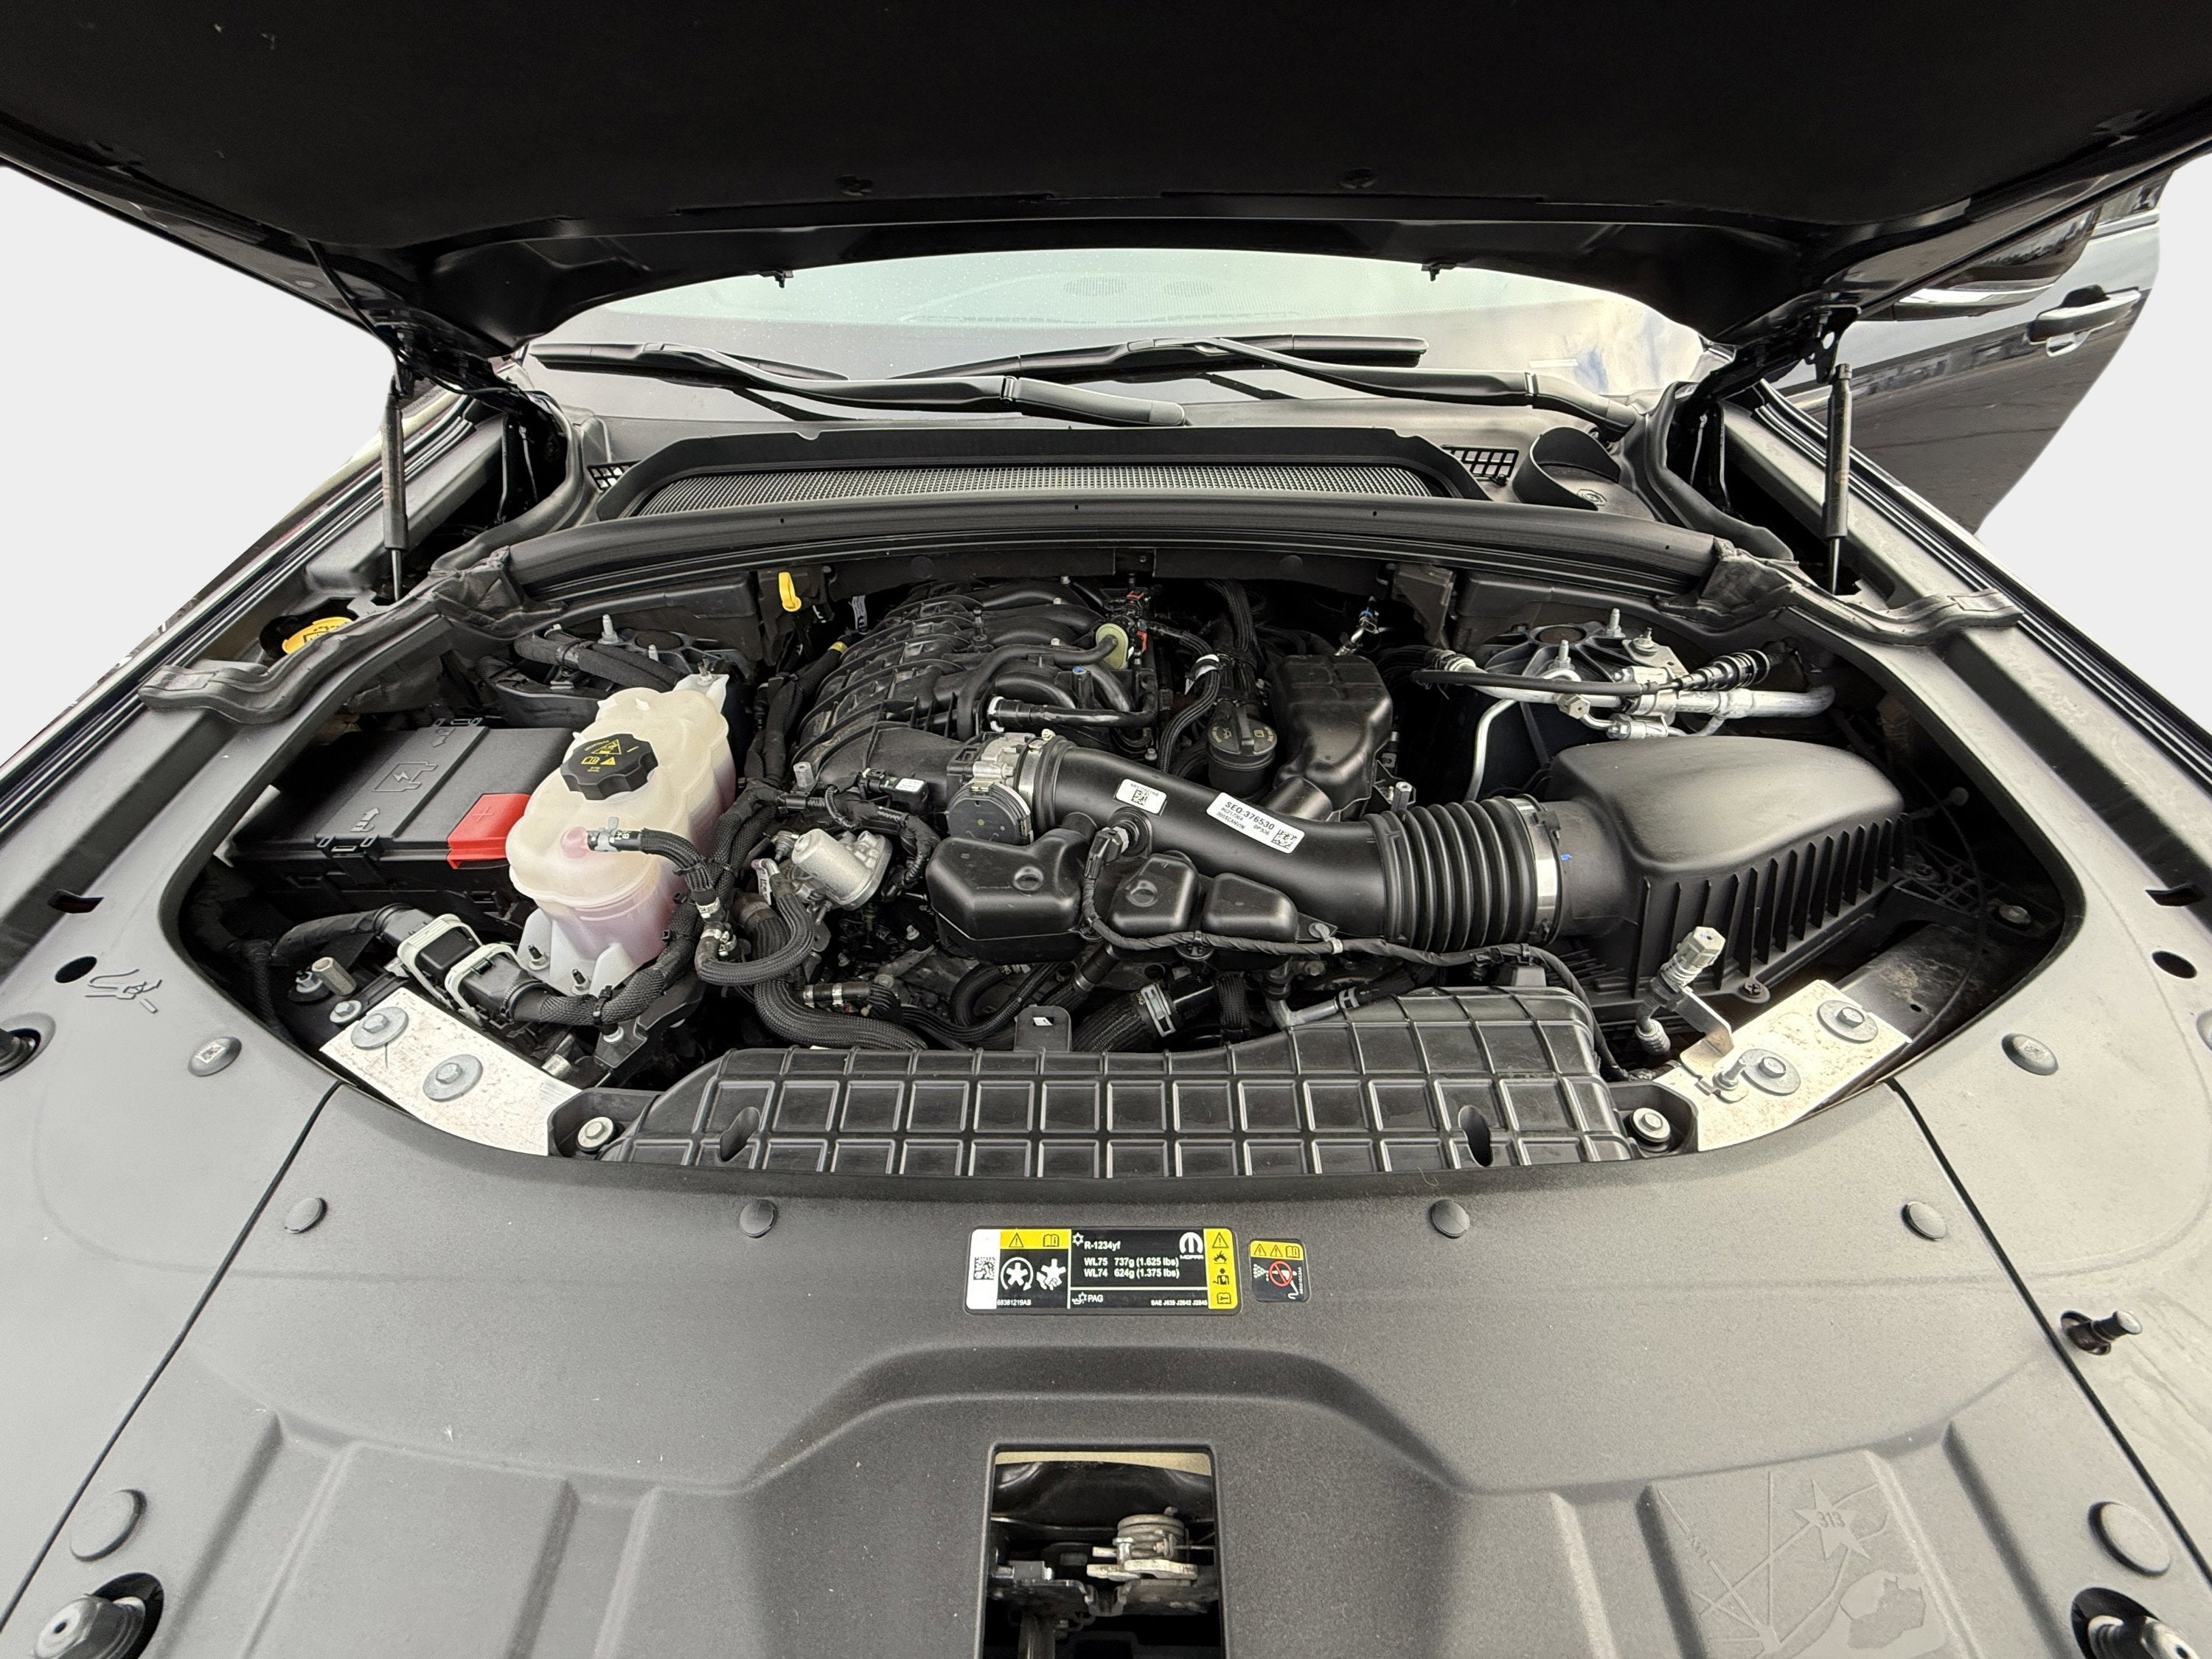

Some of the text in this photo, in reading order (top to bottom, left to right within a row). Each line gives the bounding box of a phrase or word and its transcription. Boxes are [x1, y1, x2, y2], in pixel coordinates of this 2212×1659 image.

[1084, 1241, 1121, 1251] R-1234yf
[1084, 1257, 1179, 1267] WL75 737g (1.625 lbs)
[1084, 1268, 1180, 1279] WL74 624g (1.375 lbs)
[1816, 1510, 1846, 1528] 313
